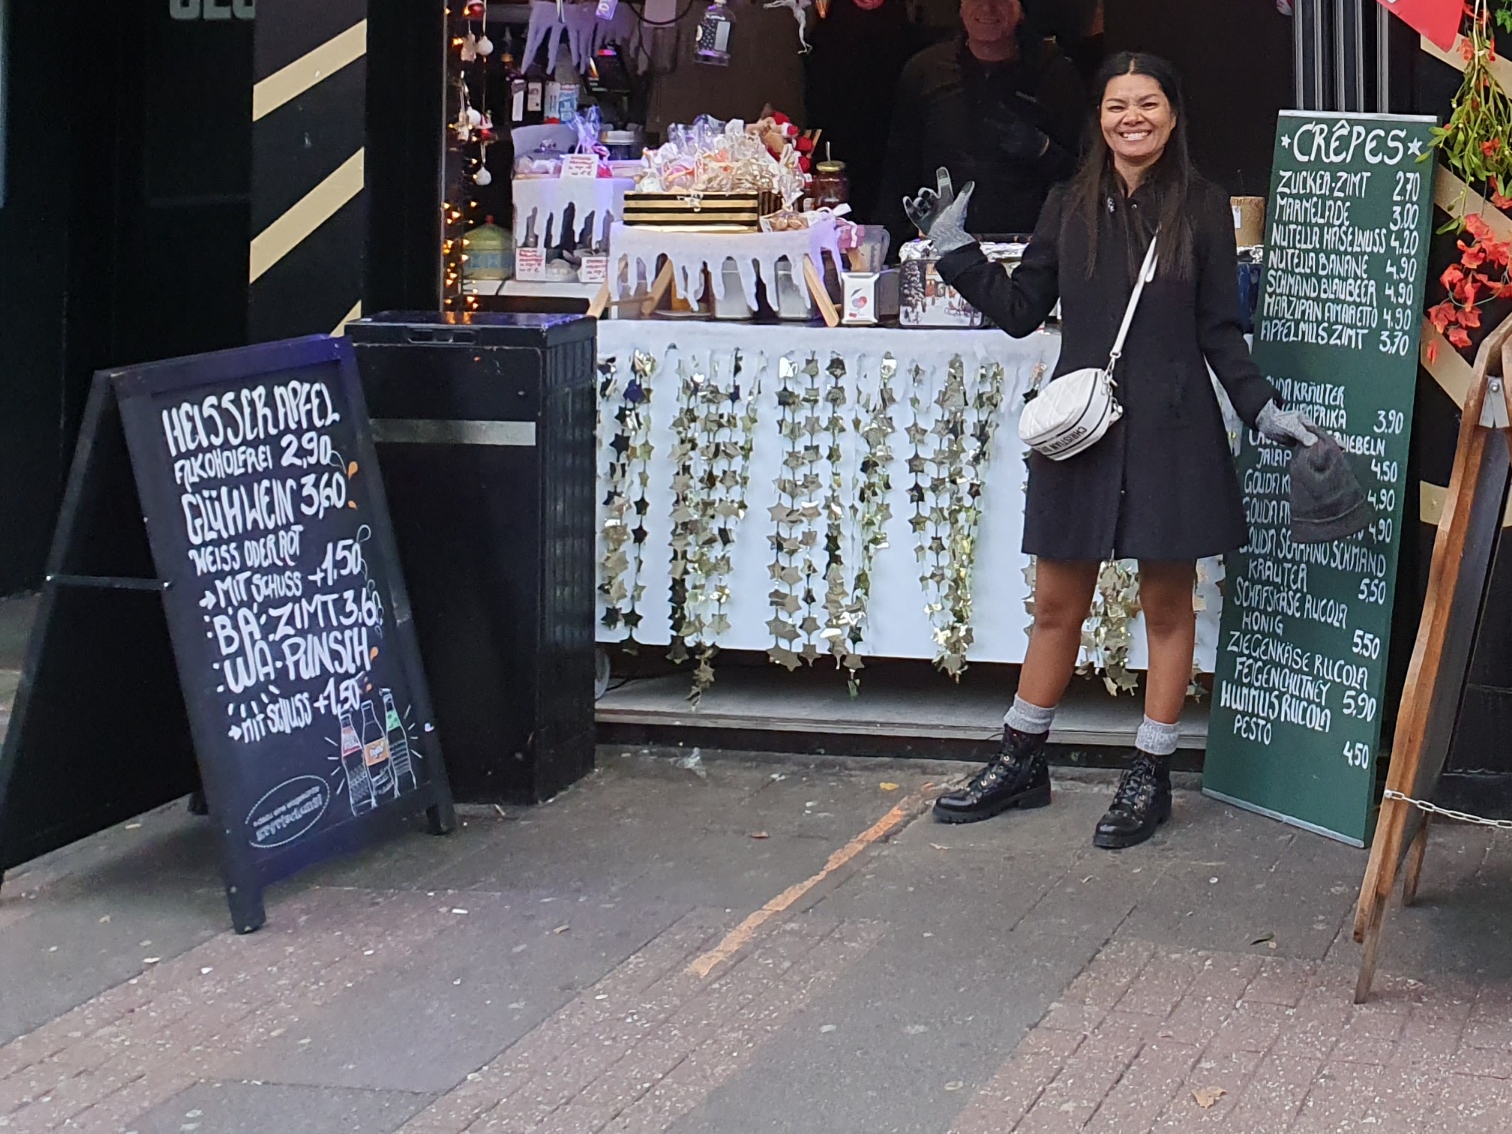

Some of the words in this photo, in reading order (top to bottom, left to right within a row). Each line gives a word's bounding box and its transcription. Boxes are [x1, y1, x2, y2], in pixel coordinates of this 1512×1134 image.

[1293, 120, 1407, 164] CRÊPES
[1275, 195, 1350, 225] MARMELADE
[1271, 223, 1319, 250] NUTELLA
[1323, 226, 1387, 254] HASELNUSS
[1268, 248, 1316, 273] NUTELLA
[1318, 252, 1369, 277] BANANE
[1266, 270, 1318, 297] SCHMAND
[1264, 294, 1322, 321] MARZIPAN
[1323, 301, 1378, 329] AMARETTO
[1260, 320, 1327, 346] APFELMUS
[1329, 324, 1369, 349] ZIMT
[1293, 381, 1345, 408] KRÄUTER
[162, 384, 278, 457] HEISSER
[274, 380, 340, 431] APFEL
[1244, 469, 1280, 495] GOUDA
[181, 478, 297, 545] GLÜHWEIN
[188, 542, 241, 577] WEISS
[244, 534, 283, 569] ODER
[279, 525, 304, 566] ROT
[1239, 526, 1276, 556] OUDA
[1330, 540, 1386, 578] SCHMAND
[214, 571, 252, 608] MIT
[251, 571, 302, 603] SCHUSS
[1248, 557, 1307, 593] KRÄUTER
[1234, 578, 1301, 618] SCHAFSKÄSE
[1304, 595, 1348, 629] RUCOLA
[1242, 611, 1283, 636] HONIG
[1226, 630, 1311, 670] ZIEGENKÄSE
[1314, 654, 1368, 691] RUCOLA
[1220, 680, 1279, 720] HUMMUS
[1281, 696, 1331, 733] RUCOLA
[241, 713, 266, 743] MIT
[1233, 714, 1272, 746] PESTO
